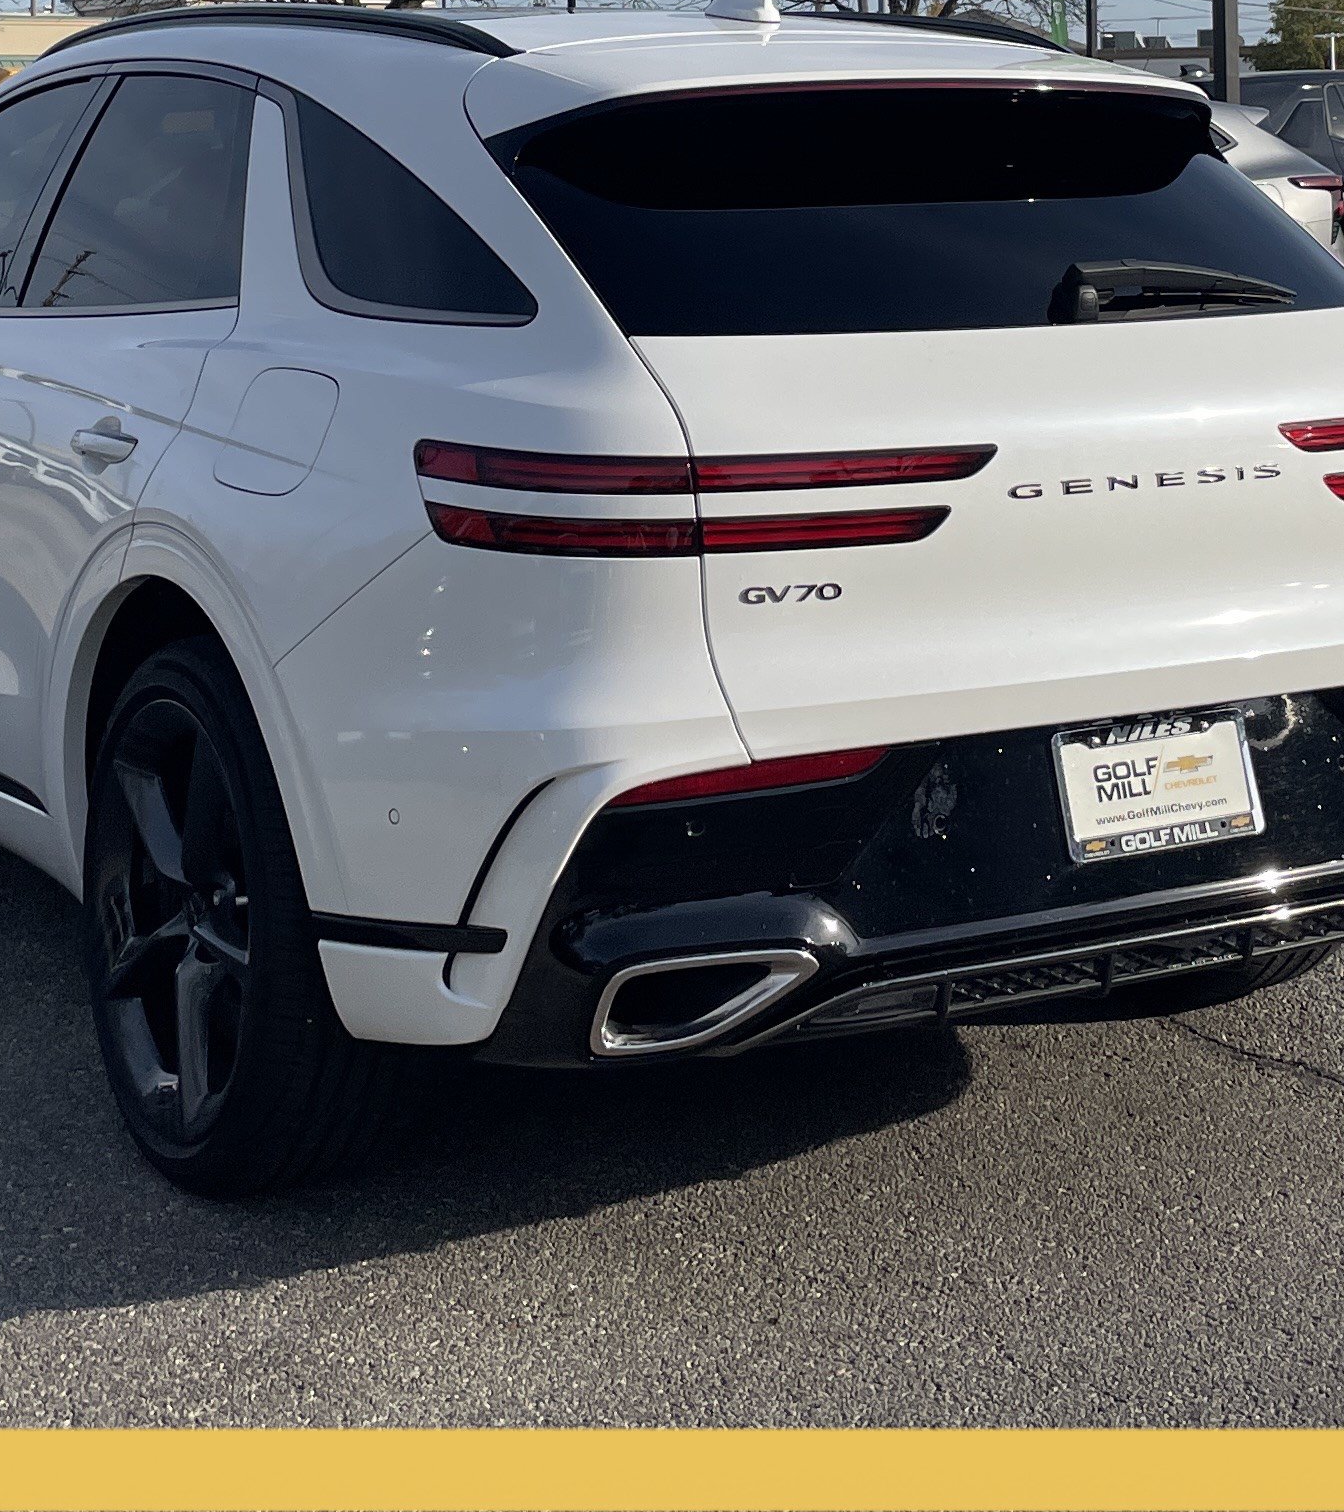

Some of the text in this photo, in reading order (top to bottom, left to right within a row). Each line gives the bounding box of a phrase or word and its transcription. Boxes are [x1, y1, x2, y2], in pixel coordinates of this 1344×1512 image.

[1007, 463, 1283, 500] GENESIS
[737, 582, 844, 605] GV70
[1106, 717, 1193, 745] NILES
[1092, 756, 1159, 784] GOLF
[1164, 774, 1218, 791] CHEVROLET
[1096, 777, 1153, 803] MILL
[1095, 796, 1229, 826] www.GolfMillChevy.com
